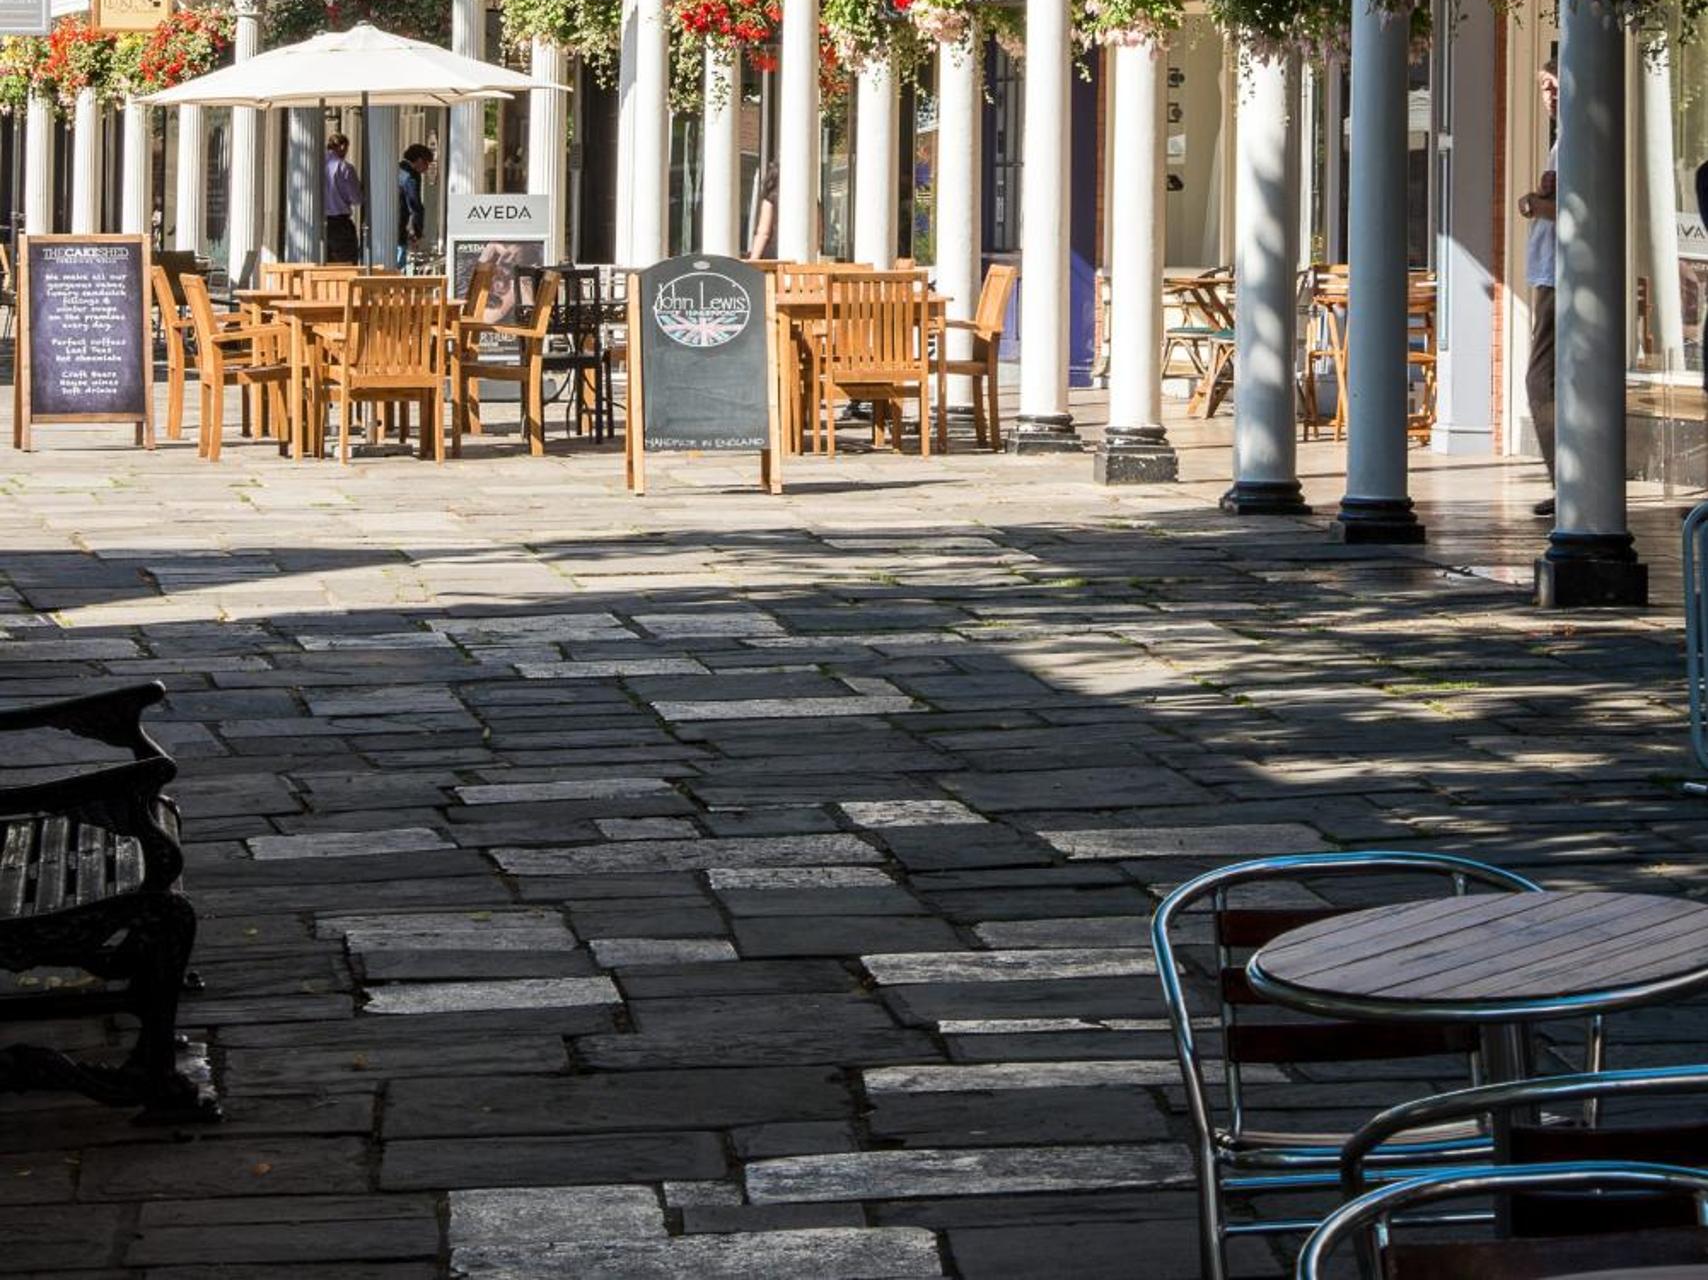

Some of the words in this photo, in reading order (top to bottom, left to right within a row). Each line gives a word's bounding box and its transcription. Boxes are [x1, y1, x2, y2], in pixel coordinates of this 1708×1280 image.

[467, 206, 532, 219] AVEDA
[653, 283, 694, 311] John
[700, 281, 746, 310] Lewis
